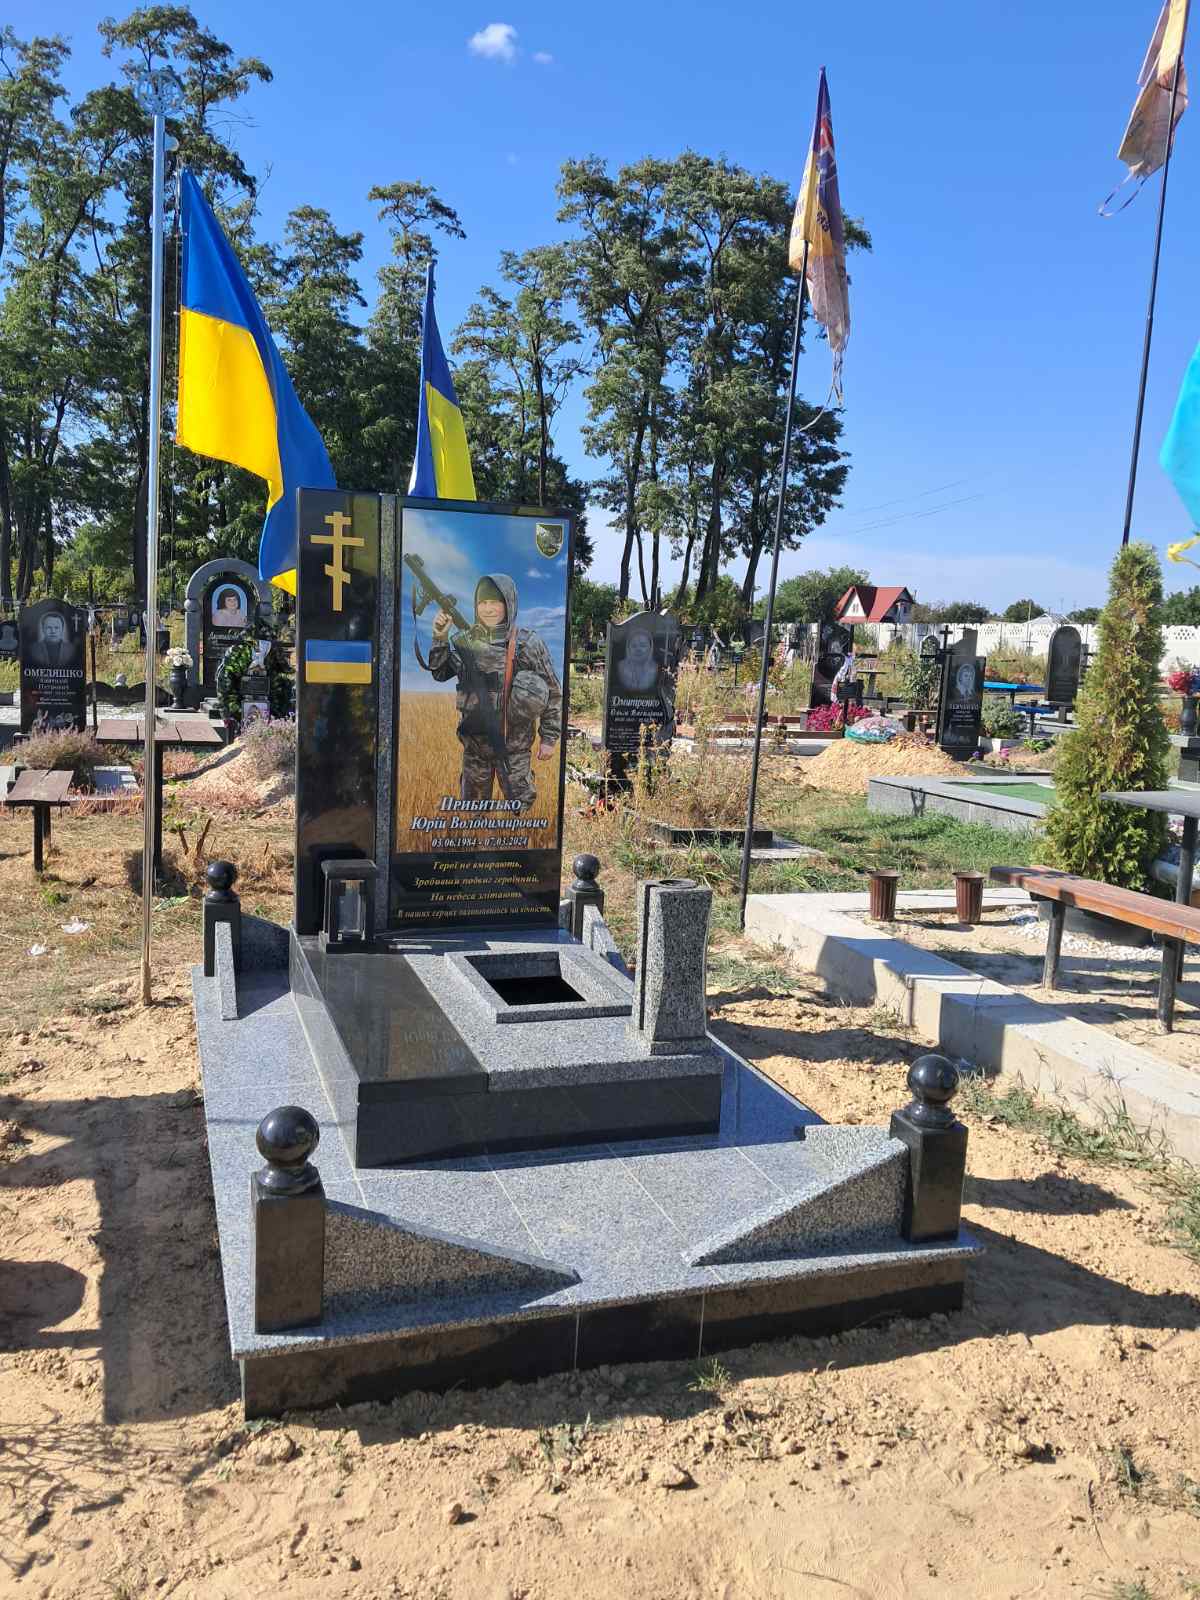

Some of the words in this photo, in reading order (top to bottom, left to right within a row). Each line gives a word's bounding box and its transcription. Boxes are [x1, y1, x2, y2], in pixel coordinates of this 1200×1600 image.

[24, 668, 83, 677] ОМЕЛЯШКО
[411, 817, 446, 831] Юрій
[450, 816, 548, 830] Володимирович
[433, 861, 460, 871] Герої
[461, 862, 471, 870] не
[415, 877, 460, 888] Зробивши
[431, 892, 447, 901] На
[450, 891, 477, 901] небеса
